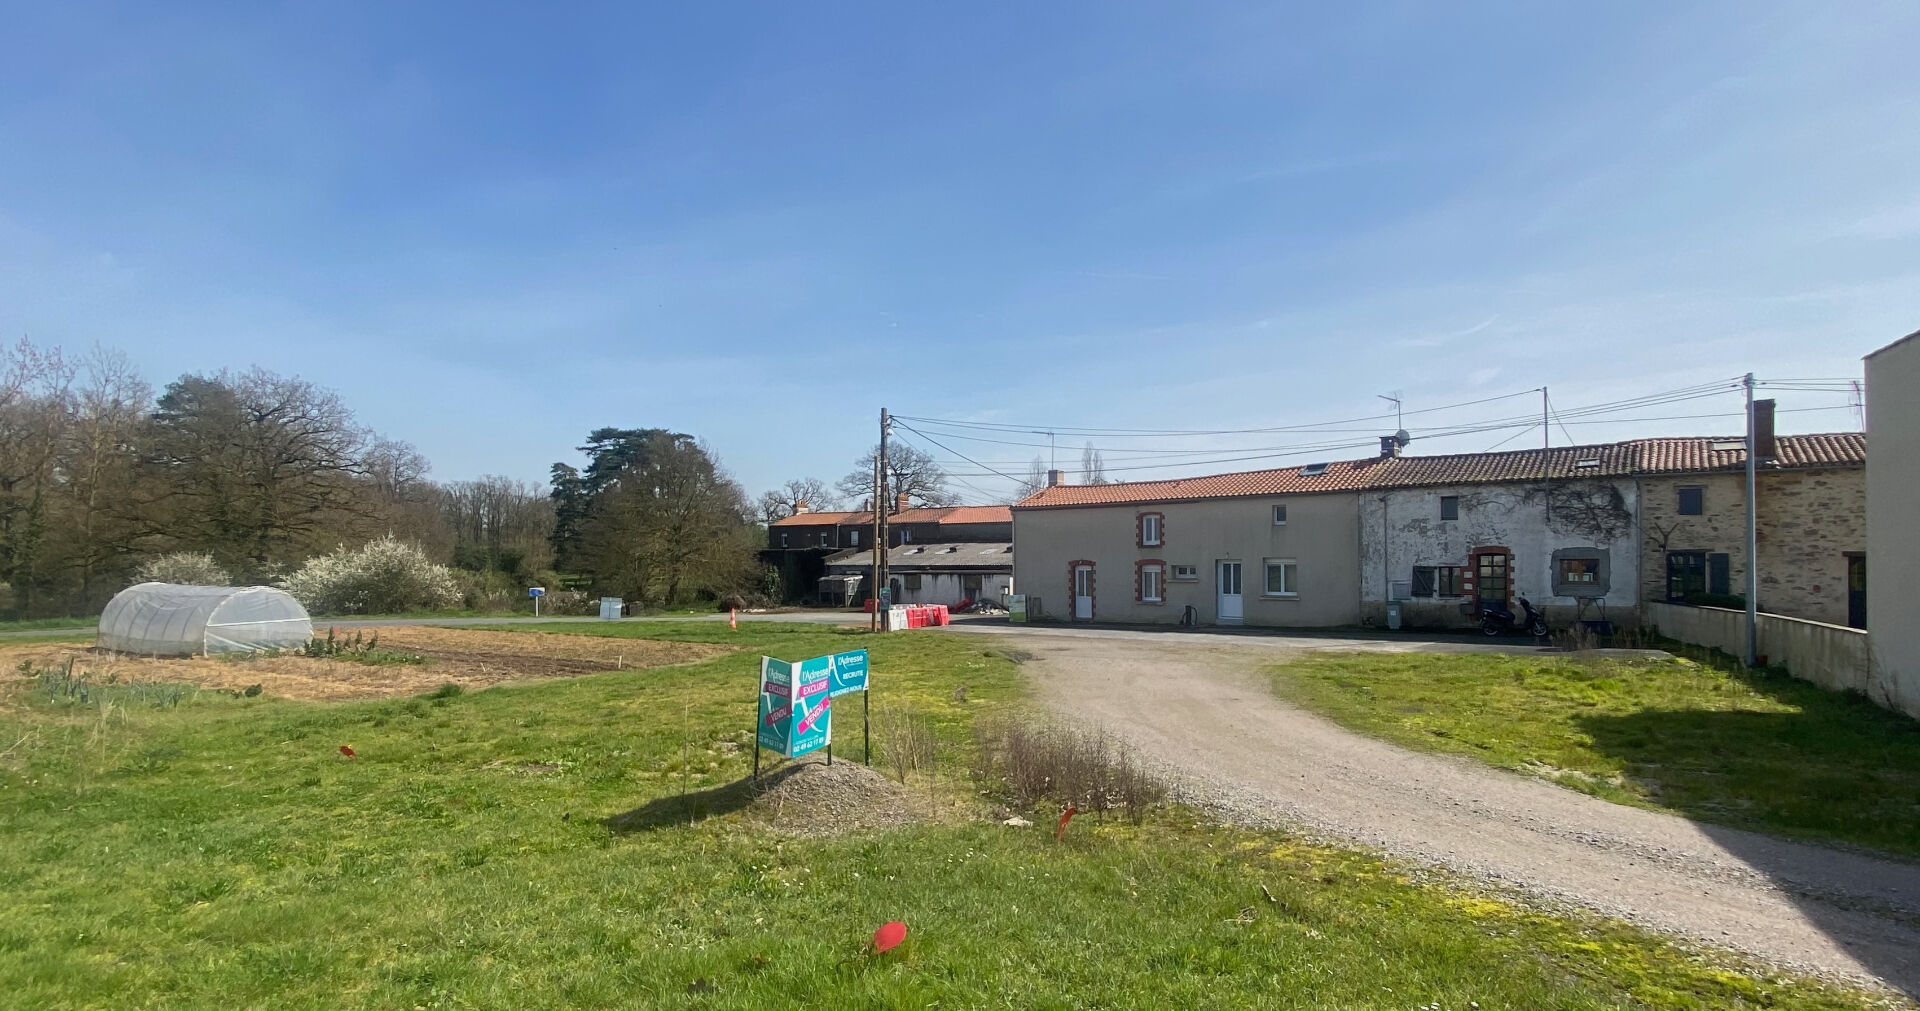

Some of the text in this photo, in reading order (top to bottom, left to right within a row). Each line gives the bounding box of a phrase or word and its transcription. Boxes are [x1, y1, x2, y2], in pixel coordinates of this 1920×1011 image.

[768, 683, 789, 696] EXCLUSIF
[803, 682, 828, 695] EXCLUSIF
[771, 707, 787, 721] VENDU
[805, 703, 824, 726] VENDU
